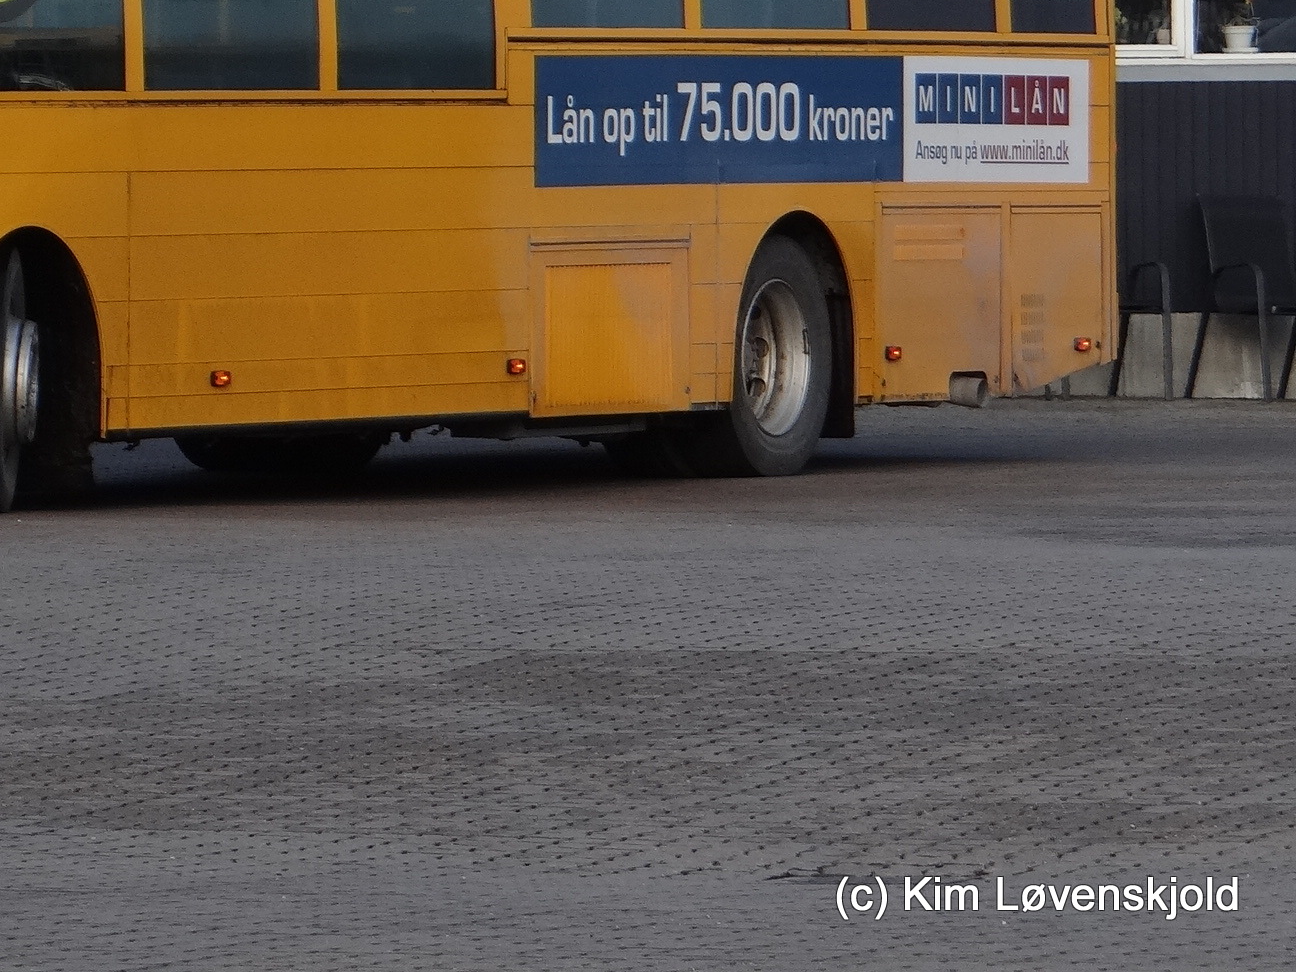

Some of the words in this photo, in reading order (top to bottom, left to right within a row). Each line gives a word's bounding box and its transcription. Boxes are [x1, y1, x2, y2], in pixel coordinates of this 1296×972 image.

[546, 94, 596, 144] Lån
[602, 106, 635, 157] op
[642, 93, 668, 144] til
[676, 81, 801, 143] 75.000
[808, 93, 895, 142] kroner
[914, 139, 949, 165] Ansøg
[950, 144, 963, 160] nu
[964, 140, 978, 165] på
[979, 138, 1070, 164] www.minilån.dk
